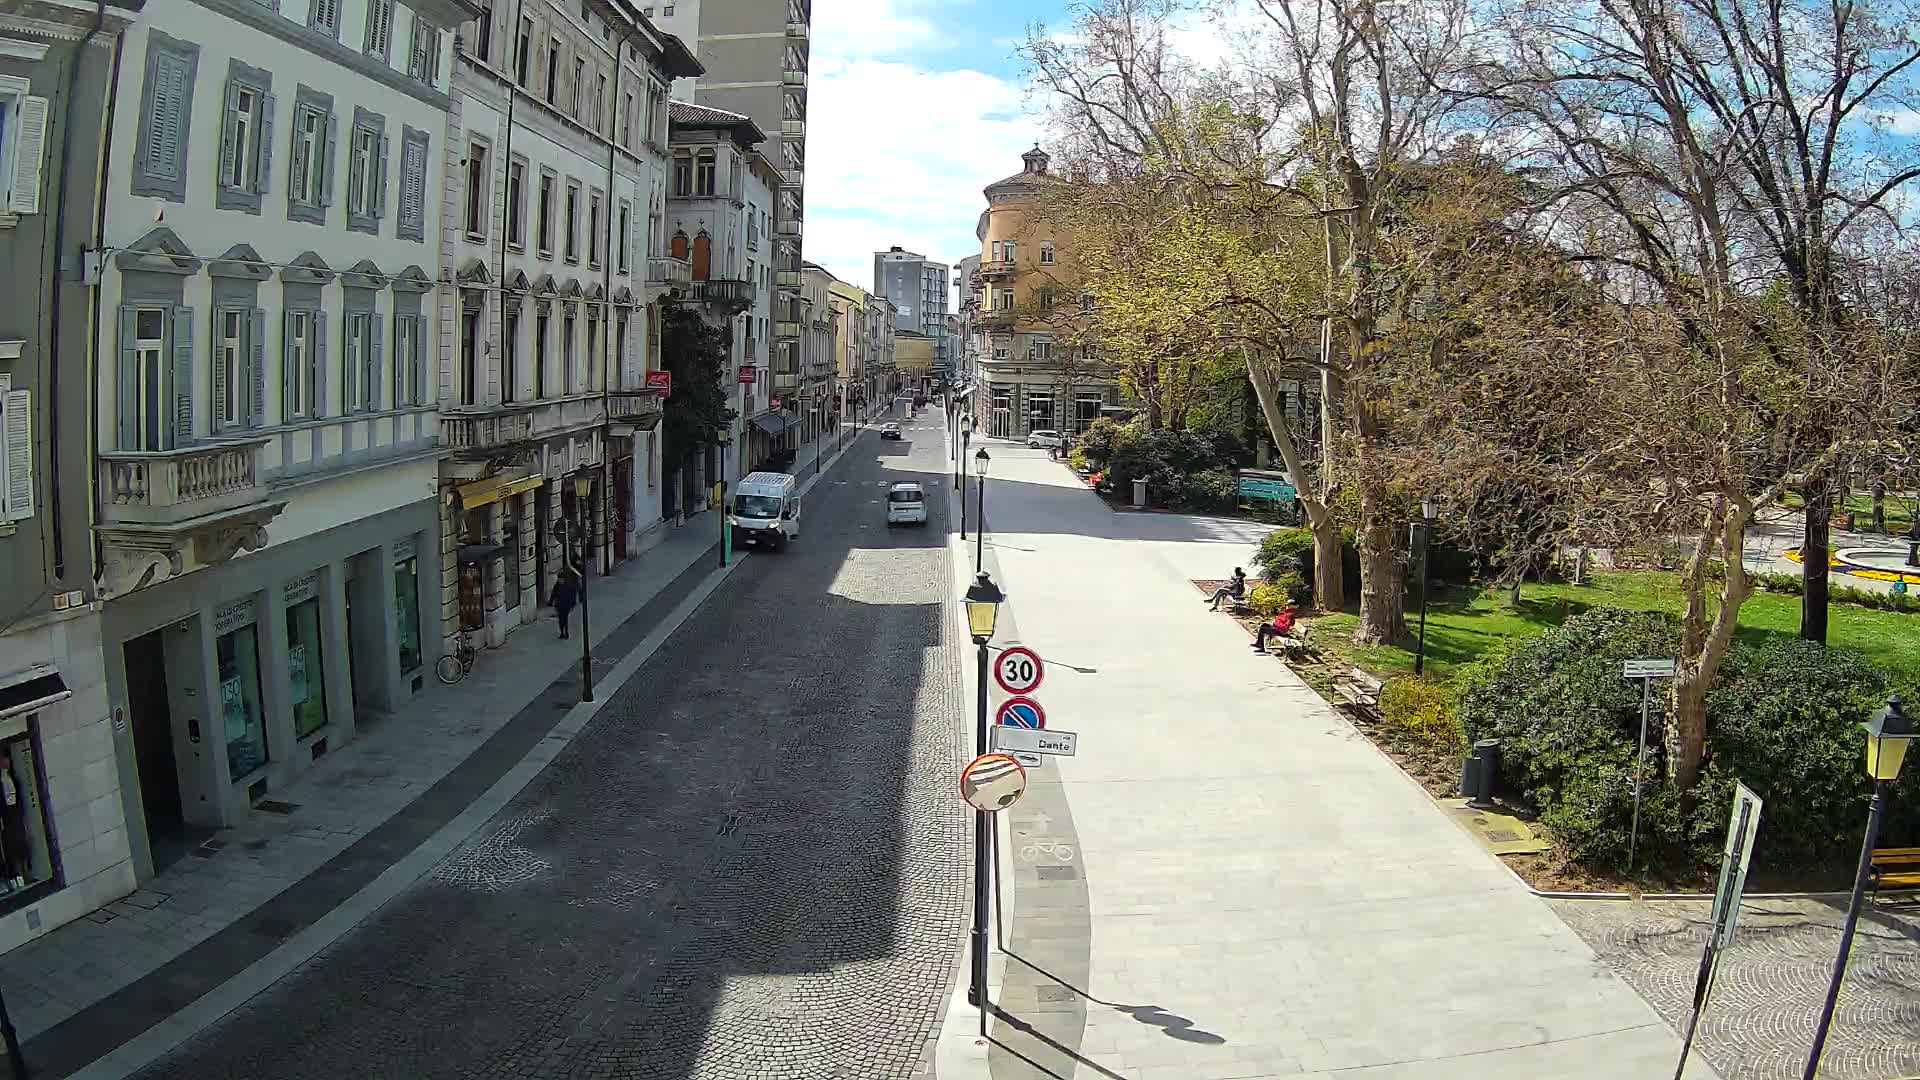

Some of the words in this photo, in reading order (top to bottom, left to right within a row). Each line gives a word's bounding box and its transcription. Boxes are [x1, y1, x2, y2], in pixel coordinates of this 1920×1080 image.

[1005, 660, 1033, 682] 30
[224, 679, 240, 702] 130
[1038, 740, 1070, 751] Dante
